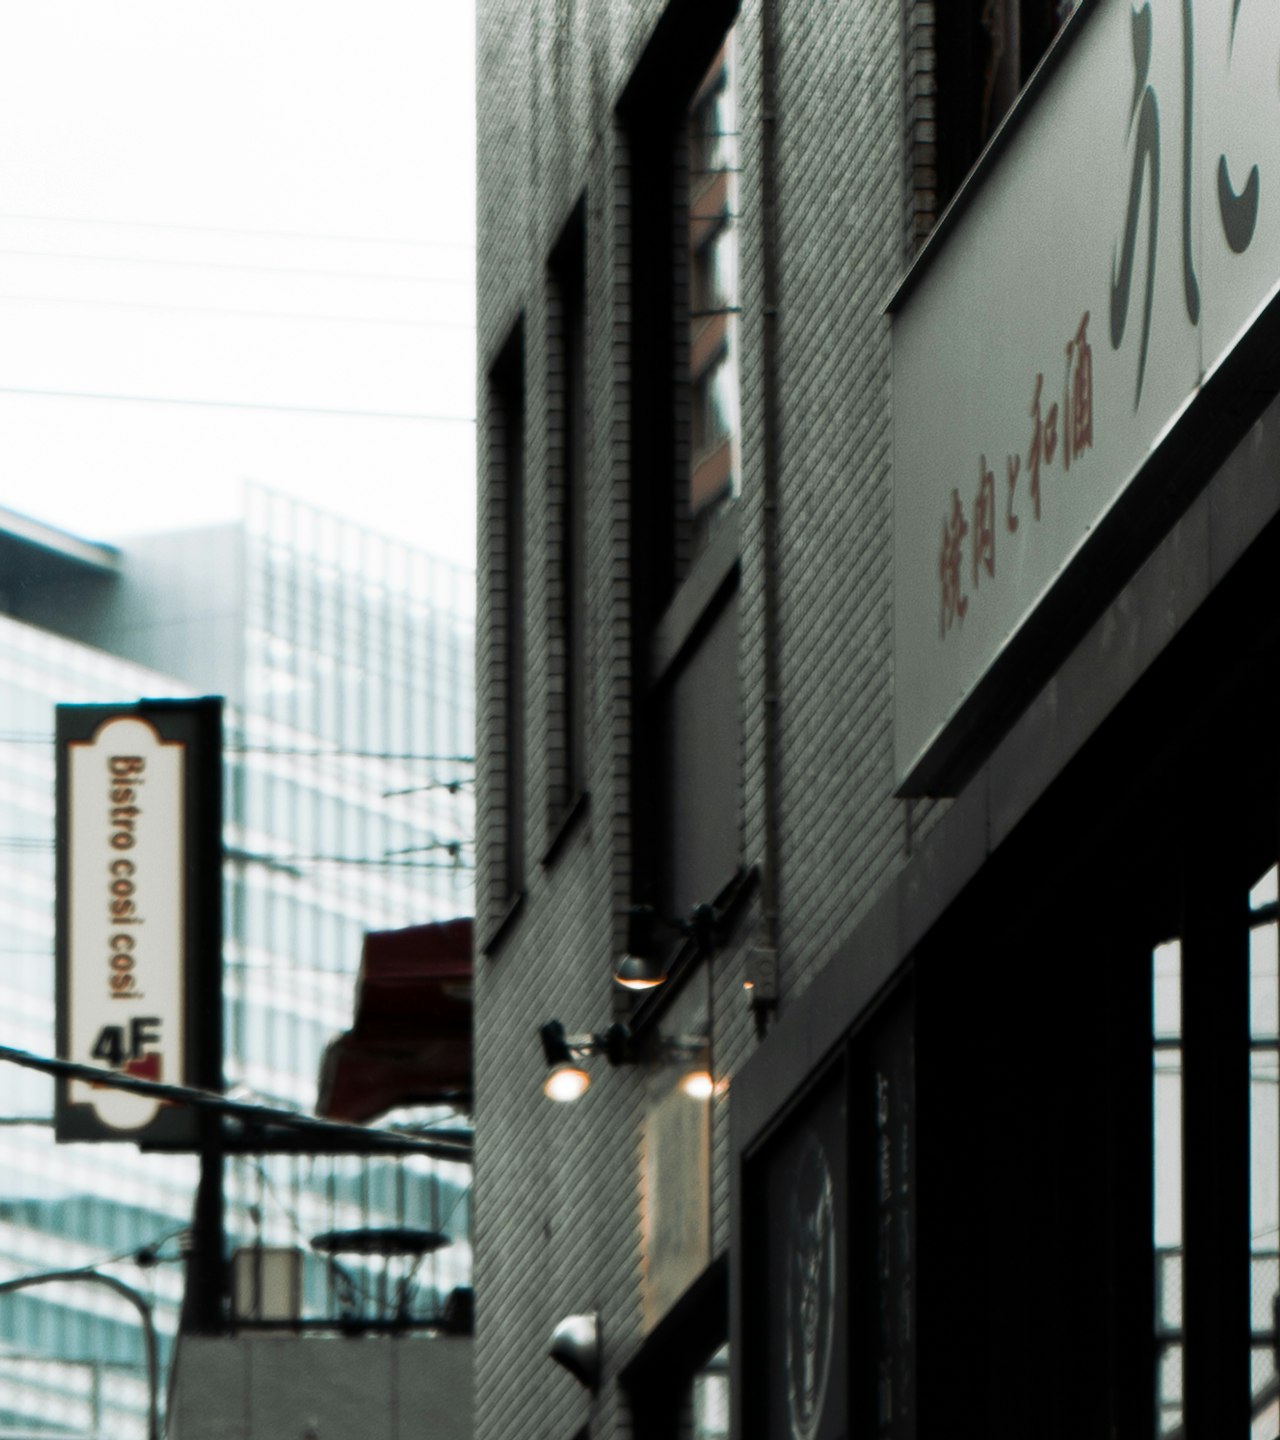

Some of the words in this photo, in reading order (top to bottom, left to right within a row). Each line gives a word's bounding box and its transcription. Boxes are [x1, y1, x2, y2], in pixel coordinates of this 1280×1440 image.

[938, 310, 1094, 642] 焼肉と和酒
[107, 754, 146, 851] Bistro
[109, 858, 145, 925] cosi
[109, 933, 145, 999] cosi
[91, 1016, 162, 1068] 4F
